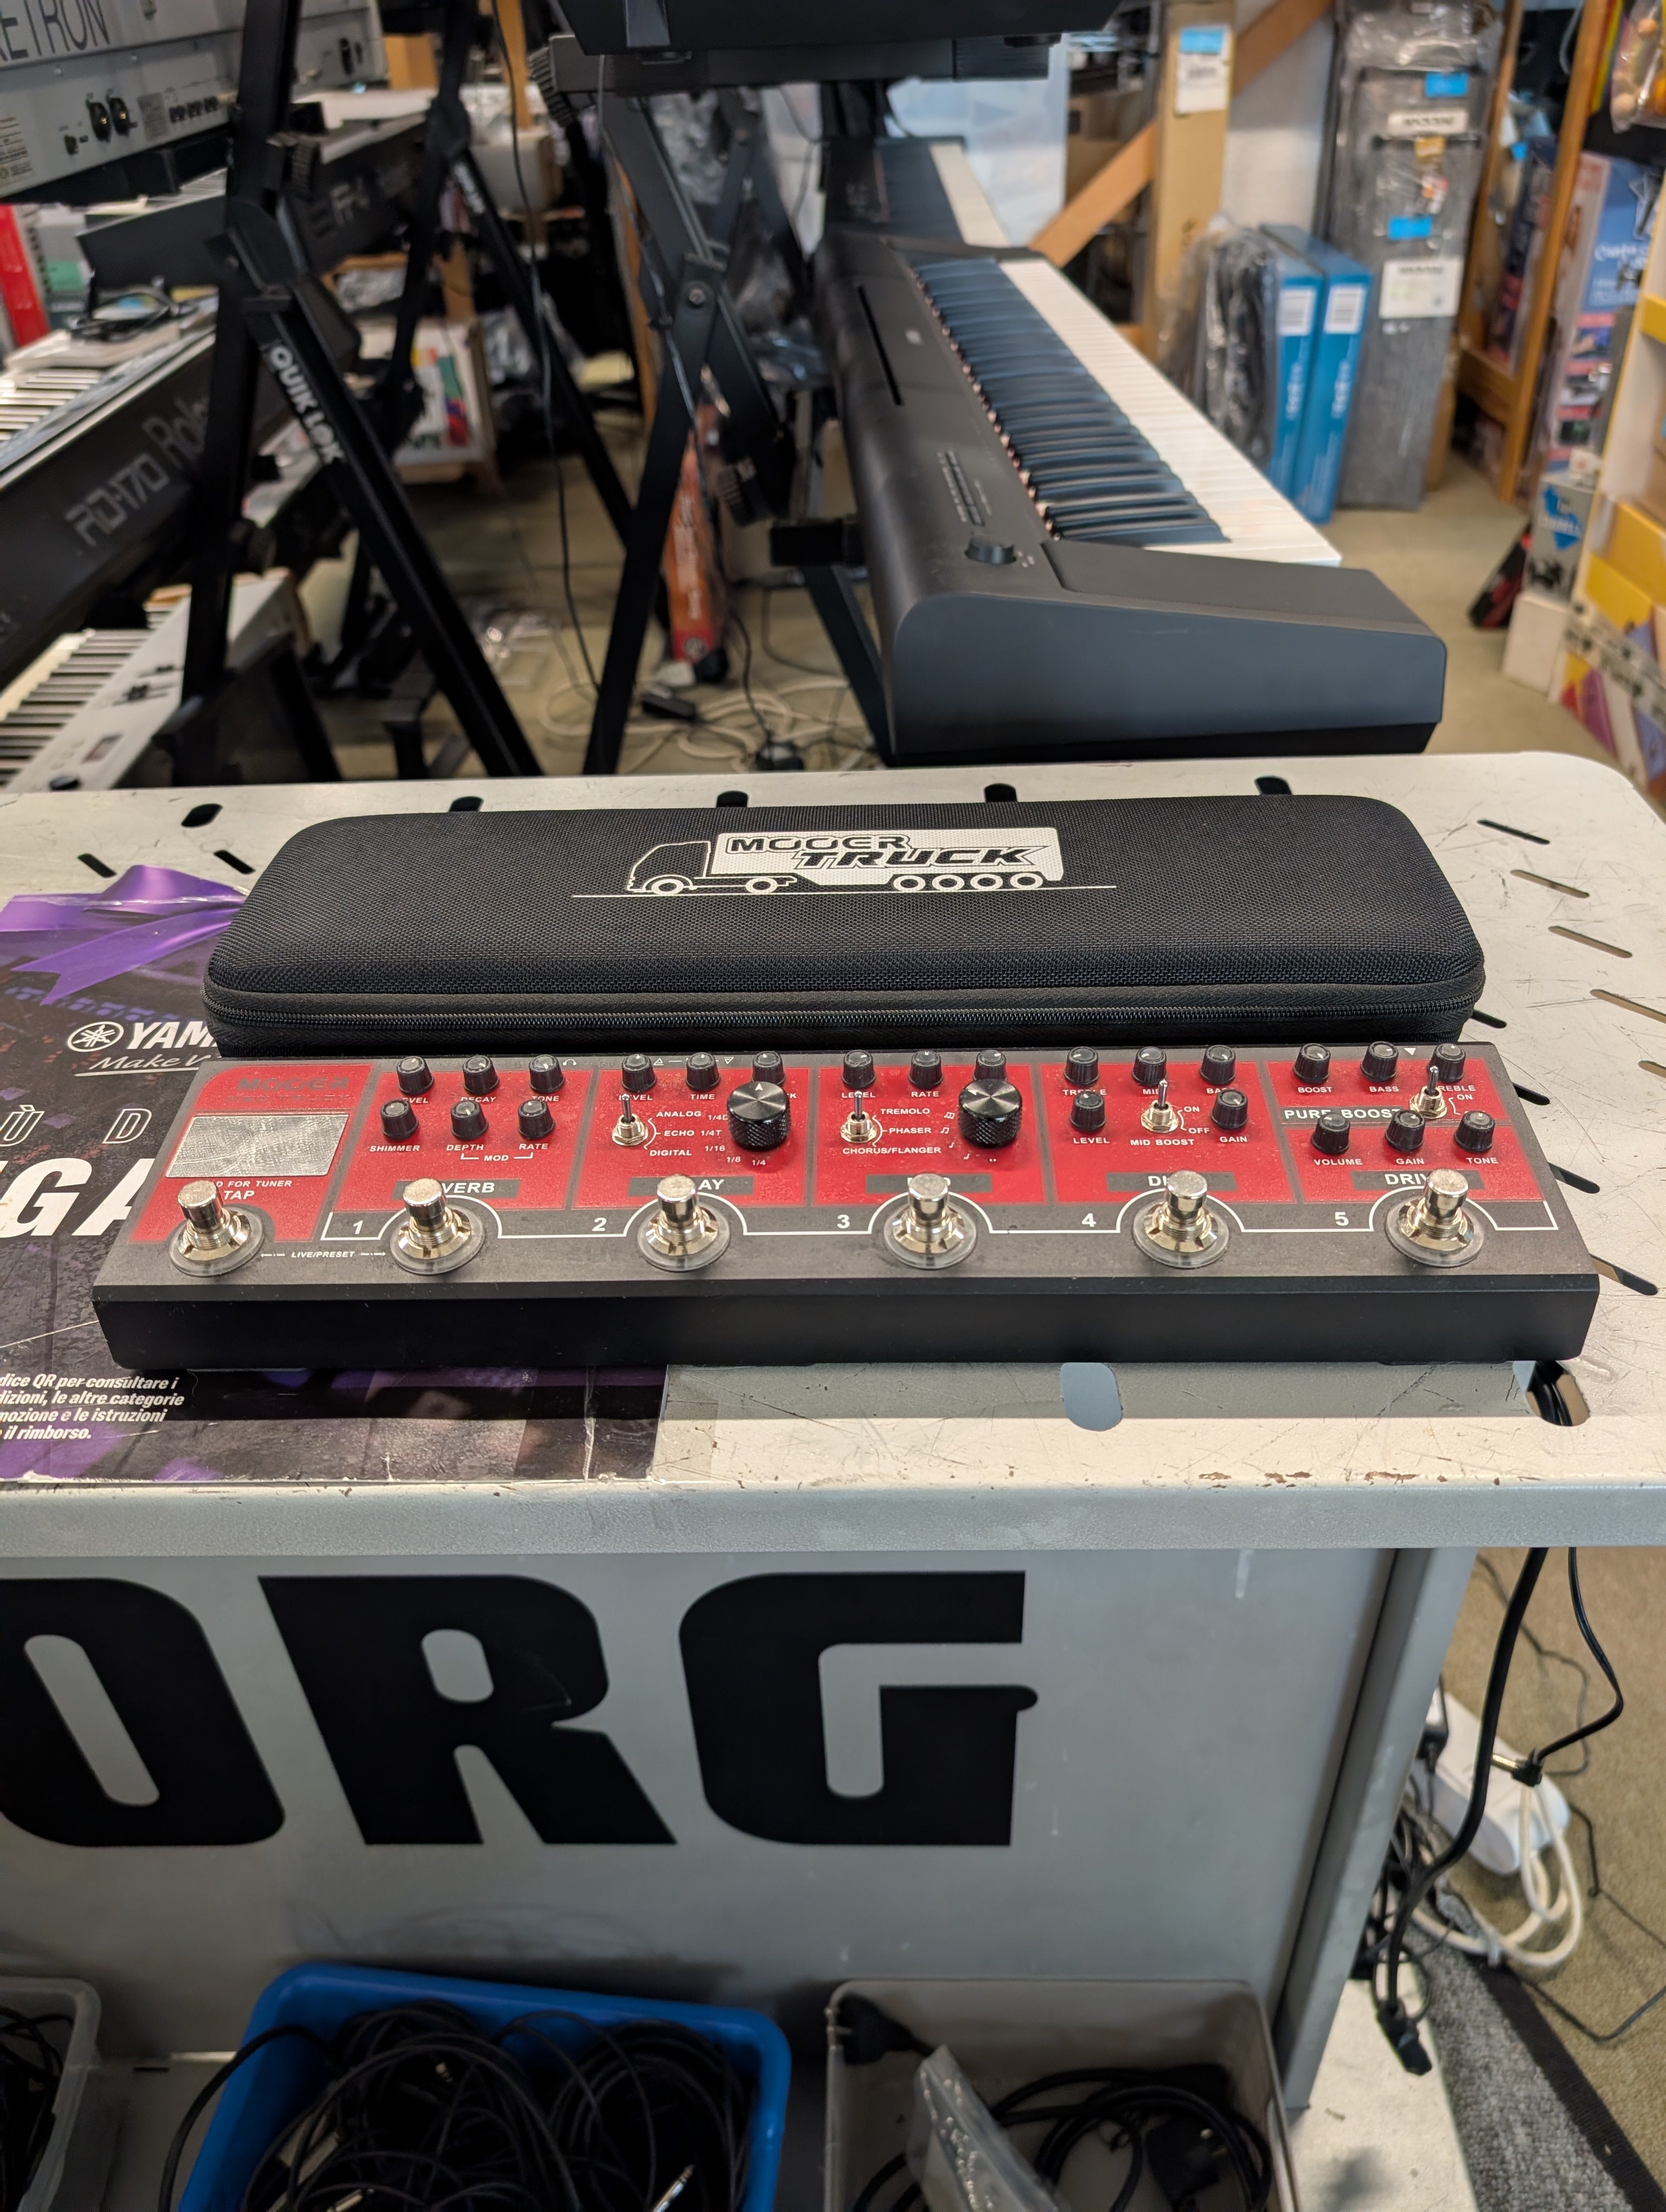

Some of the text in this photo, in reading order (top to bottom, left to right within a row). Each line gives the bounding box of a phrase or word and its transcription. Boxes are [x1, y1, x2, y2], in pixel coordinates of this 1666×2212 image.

[730, 835, 907, 852] MOOER
[802, 847, 1037, 867] TRUCK
[126, 1020, 217, 1050] YAM
[89, 1053, 182, 1070] Make
[236, 1077, 350, 1091] MOOER
[842, 1147, 941, 1155] CHORUS/FLANGER
[223, 1190, 255, 1200] TAP
[592, 1217, 607, 1232] 2
[836, 1214, 851, 1229] 3
[1081, 1212, 1097, 1227] 4
[1335, 1211, 1349, 1226] 5
[353, 1220, 363, 1235] 1
[33, 1373, 57, 1389] QR
[55, 1378, 85, 1390] per
[86, 1376, 169, 1389] consultare
[170, 1377, 180, 1389] i
[52, 1390, 67, 1404] le
[69, 1391, 110, 1404] altre
[110, 1393, 185, 1409] categorie
[60, 1411, 70, 1422] e
[73, 1407, 89, 1422] le
[91, 1409, 168, 1422] istruzioni
[3, 1425, 92, 1440] il rimborso.
